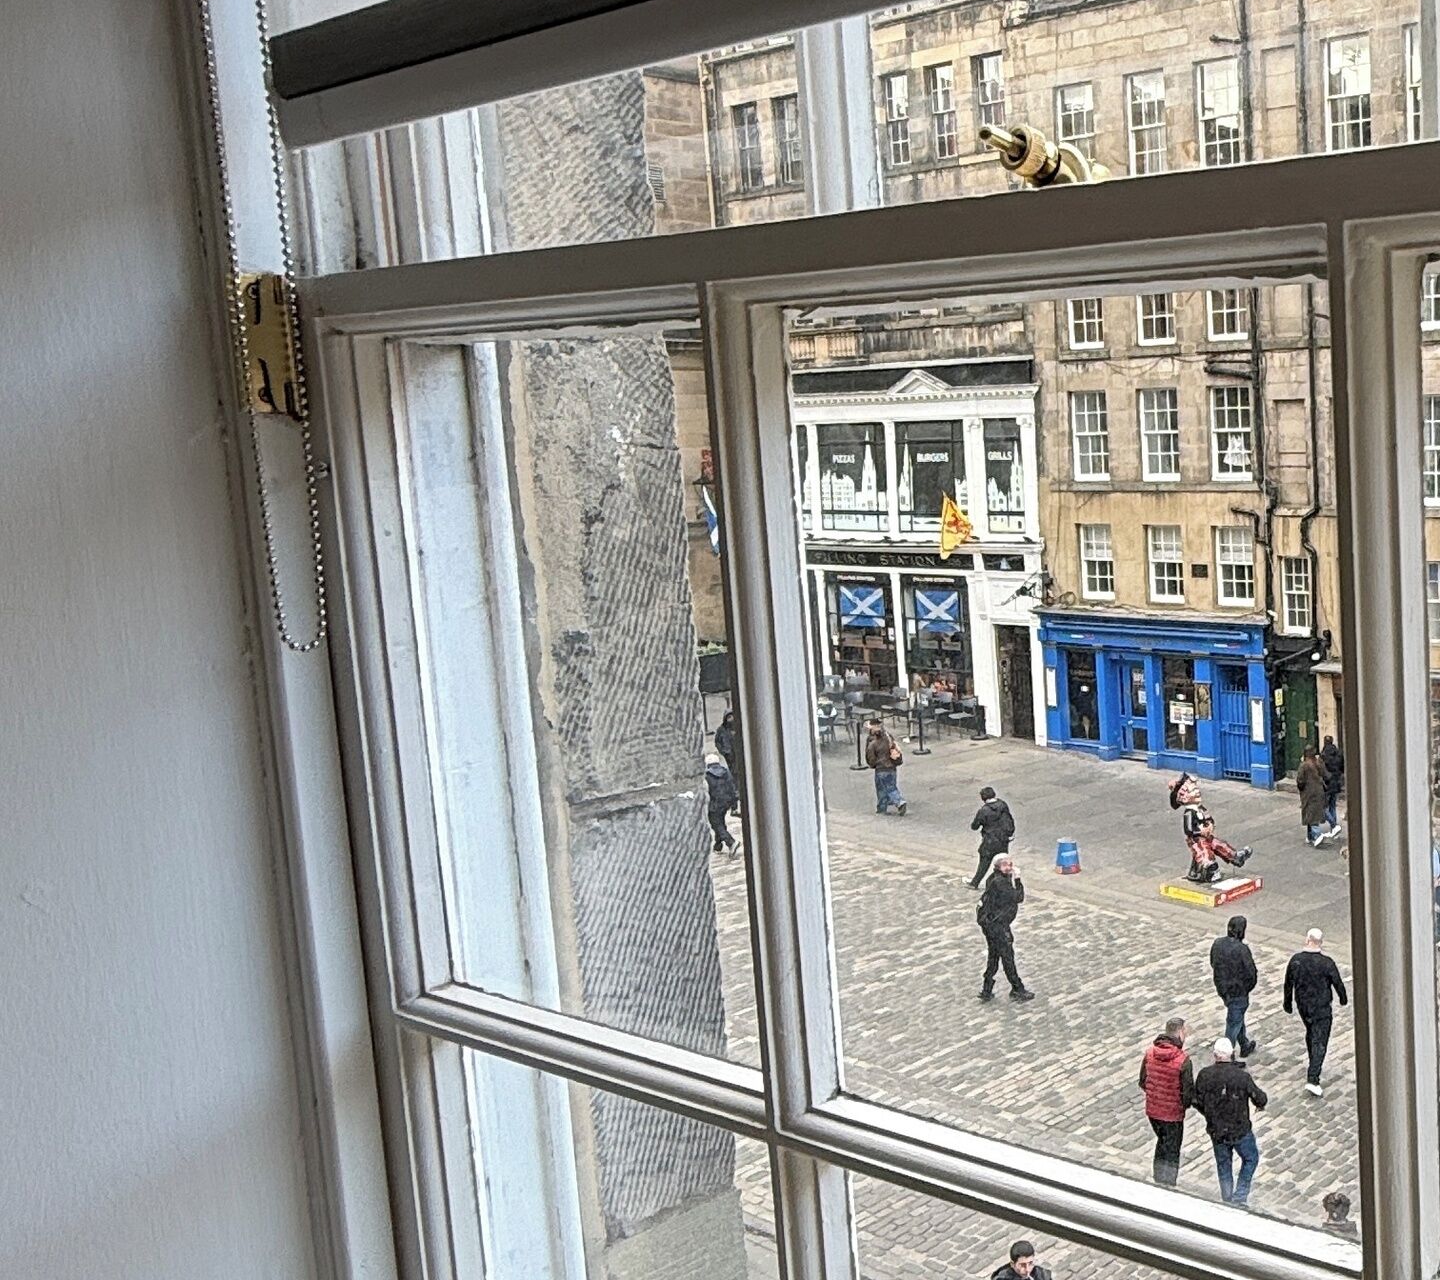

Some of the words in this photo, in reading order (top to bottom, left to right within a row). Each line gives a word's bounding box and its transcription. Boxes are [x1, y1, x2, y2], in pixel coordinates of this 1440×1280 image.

[832, 454, 855, 464] PIZZAS
[917, 452, 949, 463] BURGERS
[987, 451, 1013, 461] GRILLS
[879, 554, 936, 567] STATION
